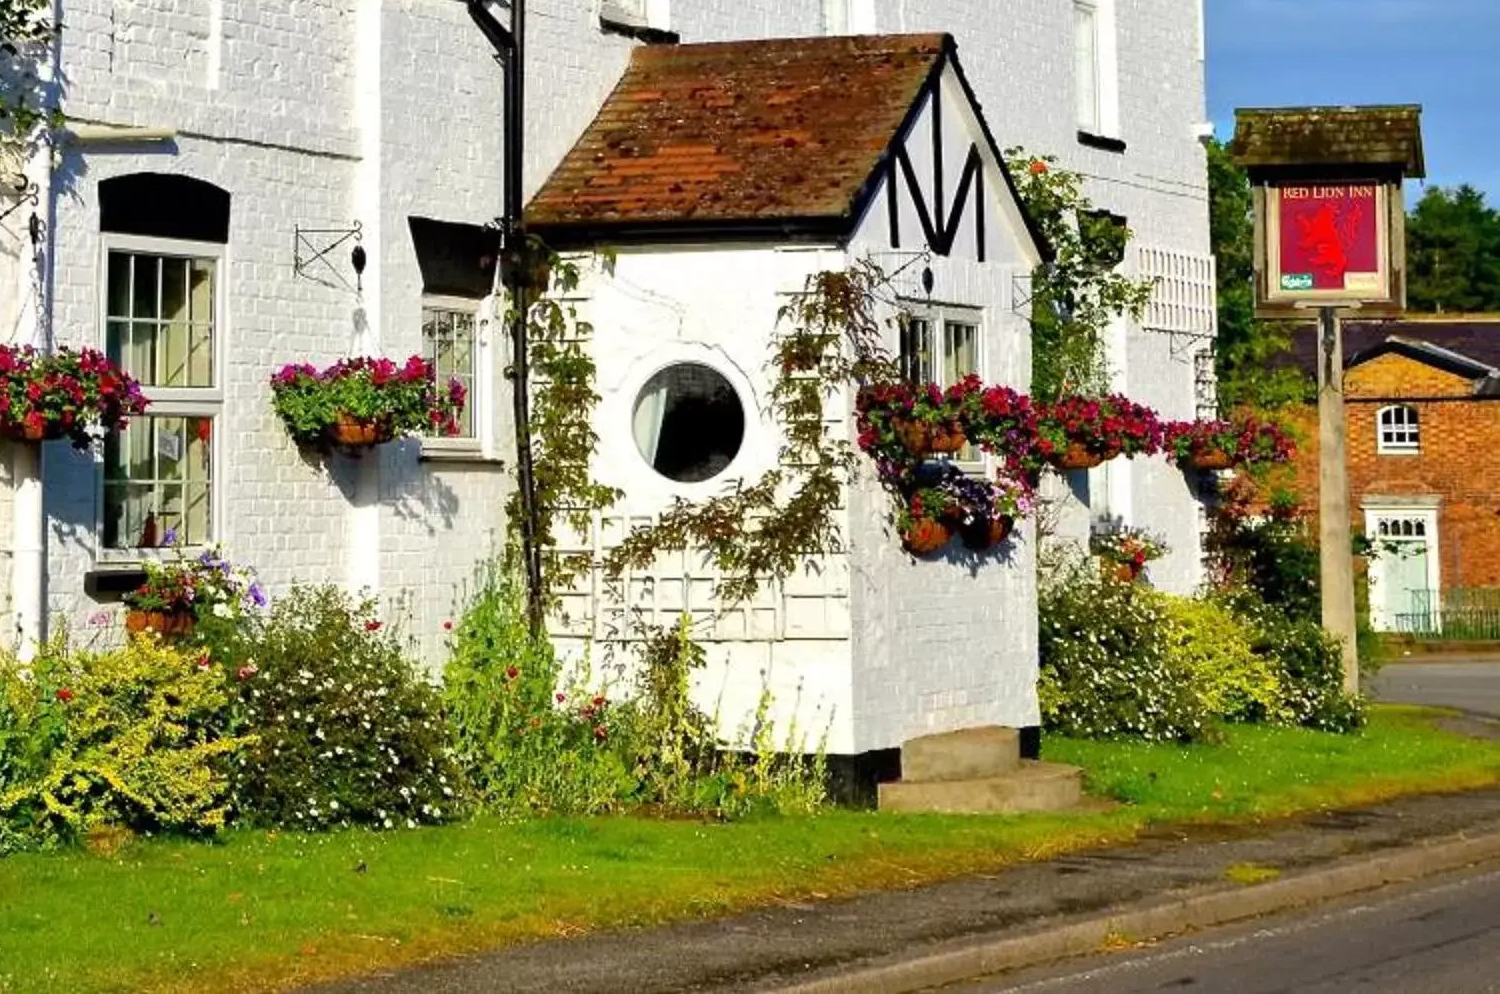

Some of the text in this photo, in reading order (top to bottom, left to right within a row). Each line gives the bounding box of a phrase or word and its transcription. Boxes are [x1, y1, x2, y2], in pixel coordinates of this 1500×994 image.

[1283, 185, 1372, 199] RED LION INN
